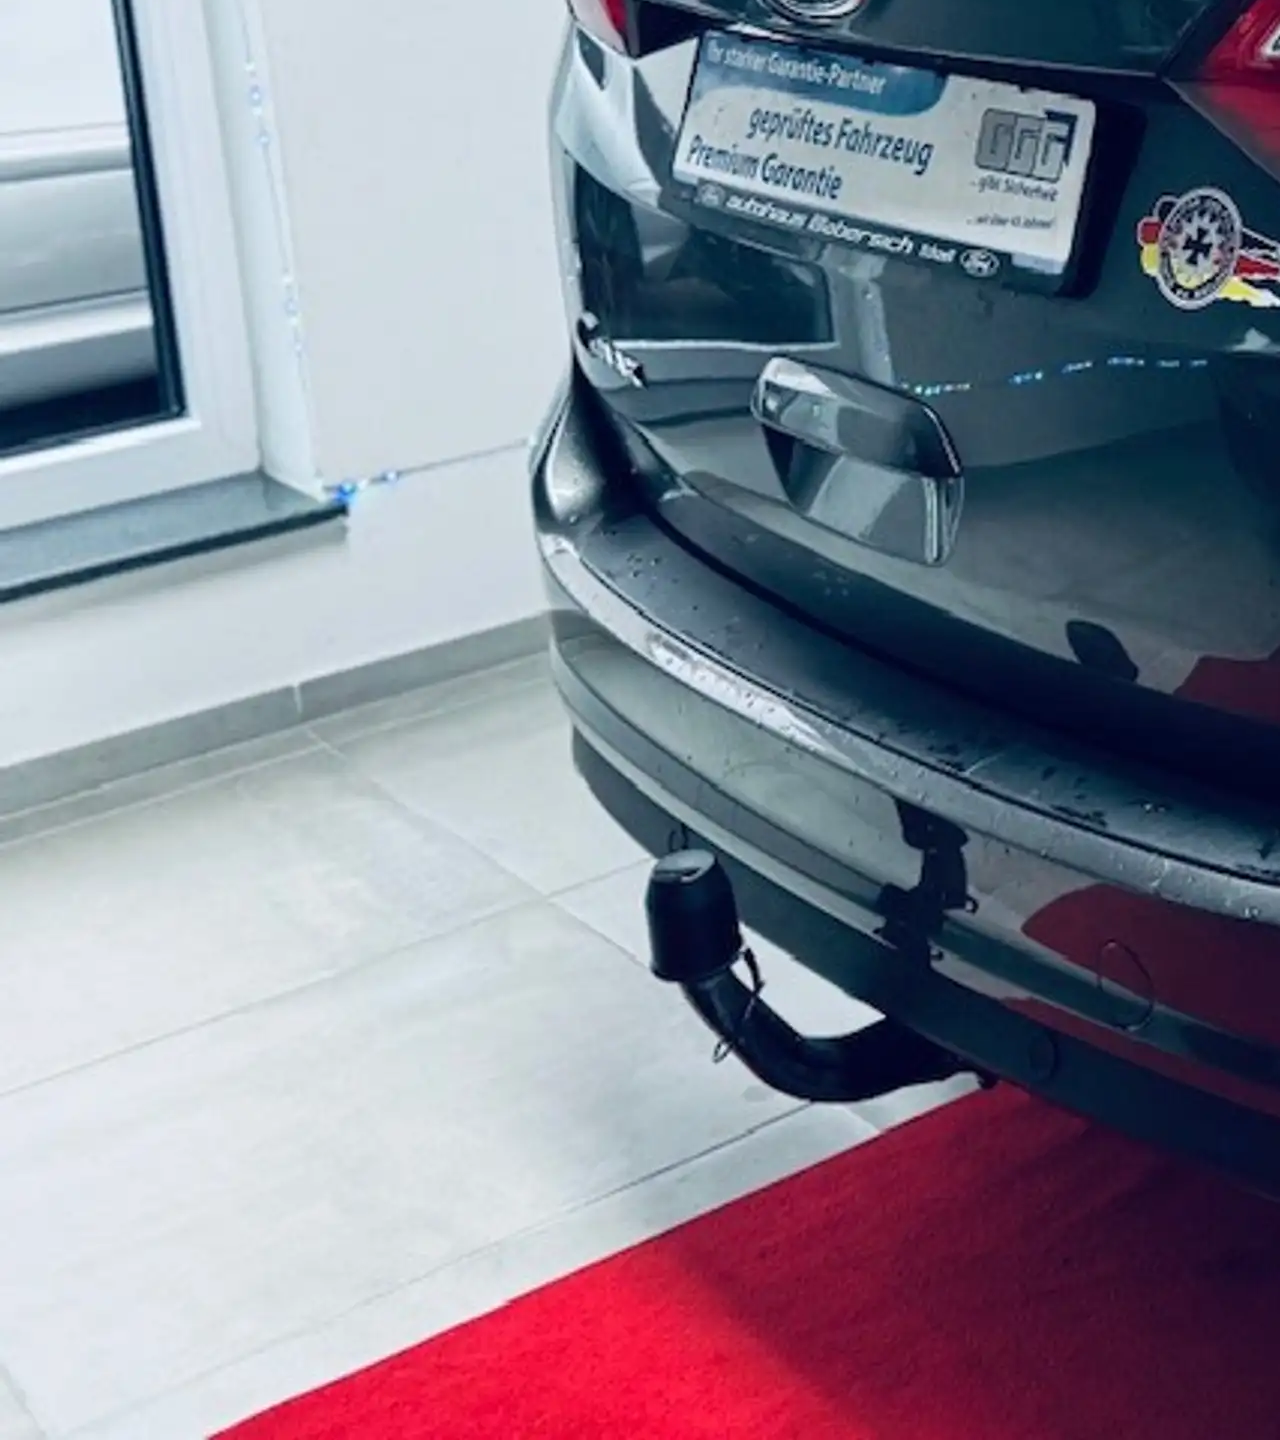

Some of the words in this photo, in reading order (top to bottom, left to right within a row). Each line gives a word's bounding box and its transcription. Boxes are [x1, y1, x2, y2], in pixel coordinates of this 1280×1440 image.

[767, 51, 887, 95] Garantie-Partner
[685, 133, 760, 179] Premium
[761, 151, 843, 200] Garantie
[745, 107, 835, 148] geprüftes
[834, 116, 935, 176] Fahrzeug
